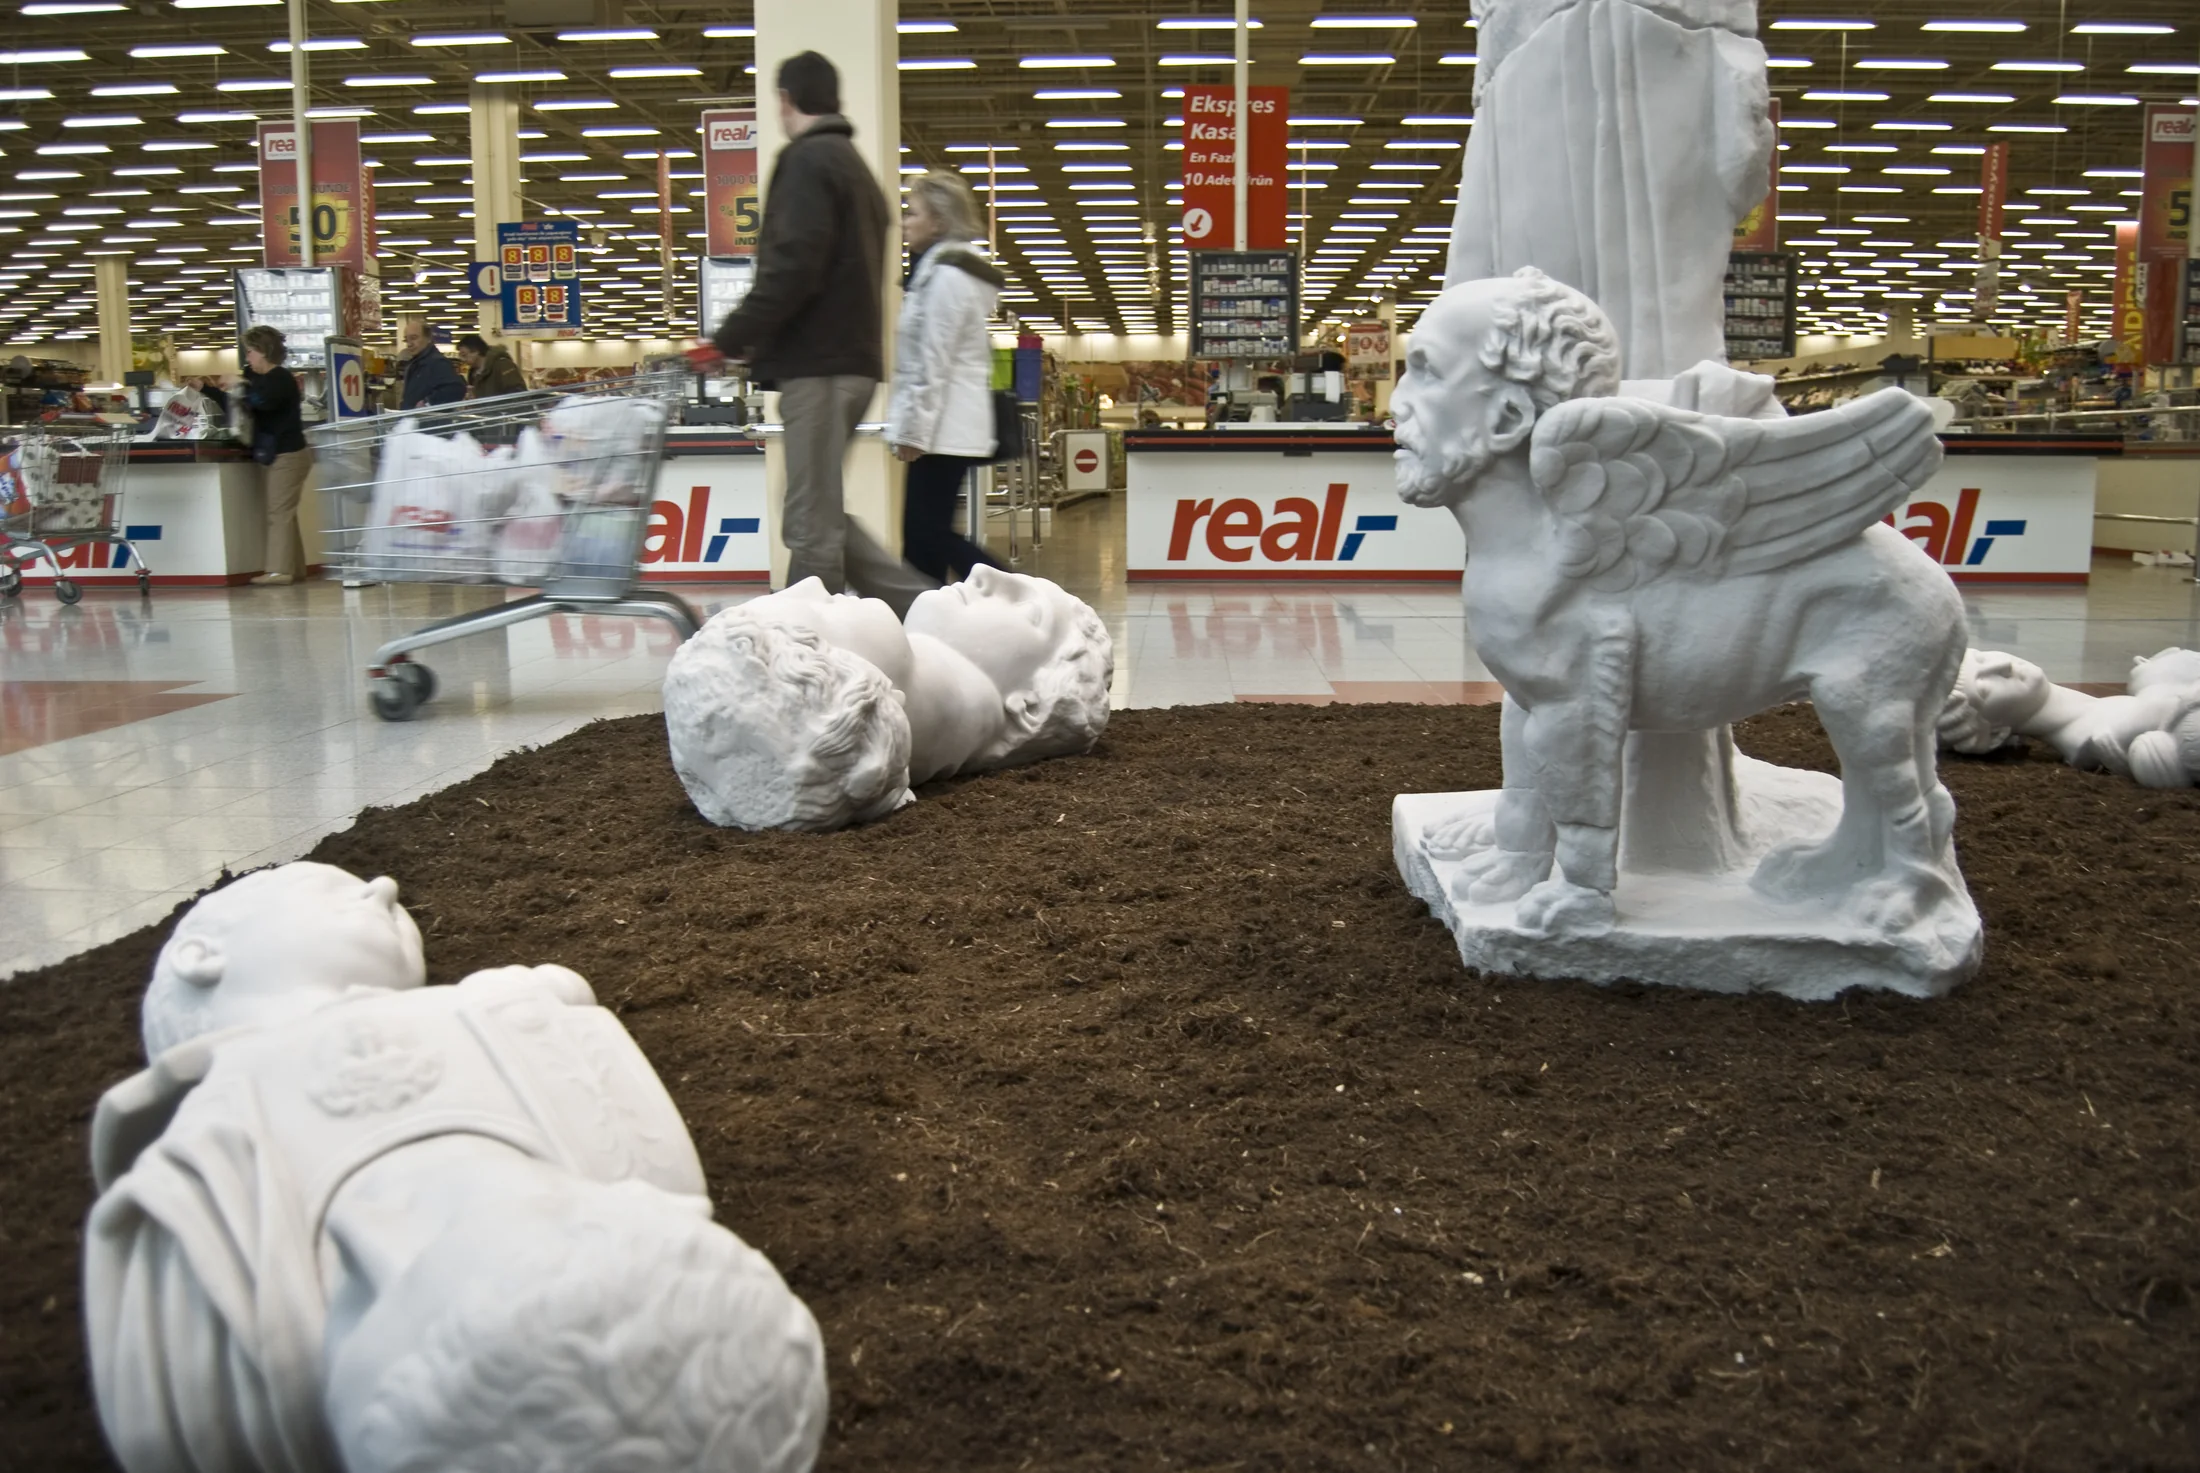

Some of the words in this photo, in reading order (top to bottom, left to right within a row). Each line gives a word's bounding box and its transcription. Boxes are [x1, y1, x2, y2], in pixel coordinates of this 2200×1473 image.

[1190, 95, 1276, 117] Ekspes
[268, 138, 296, 153] rea
[1189, 152, 1206, 163] En
[1184, 172, 1204, 186] 10
[508, 248, 517, 262] 8
[534, 248, 543, 261] 8
[560, 248, 569, 260] 8
[523, 290, 532, 303] 8
[550, 290, 559, 302] 8
[343, 374, 359, 396] 11
